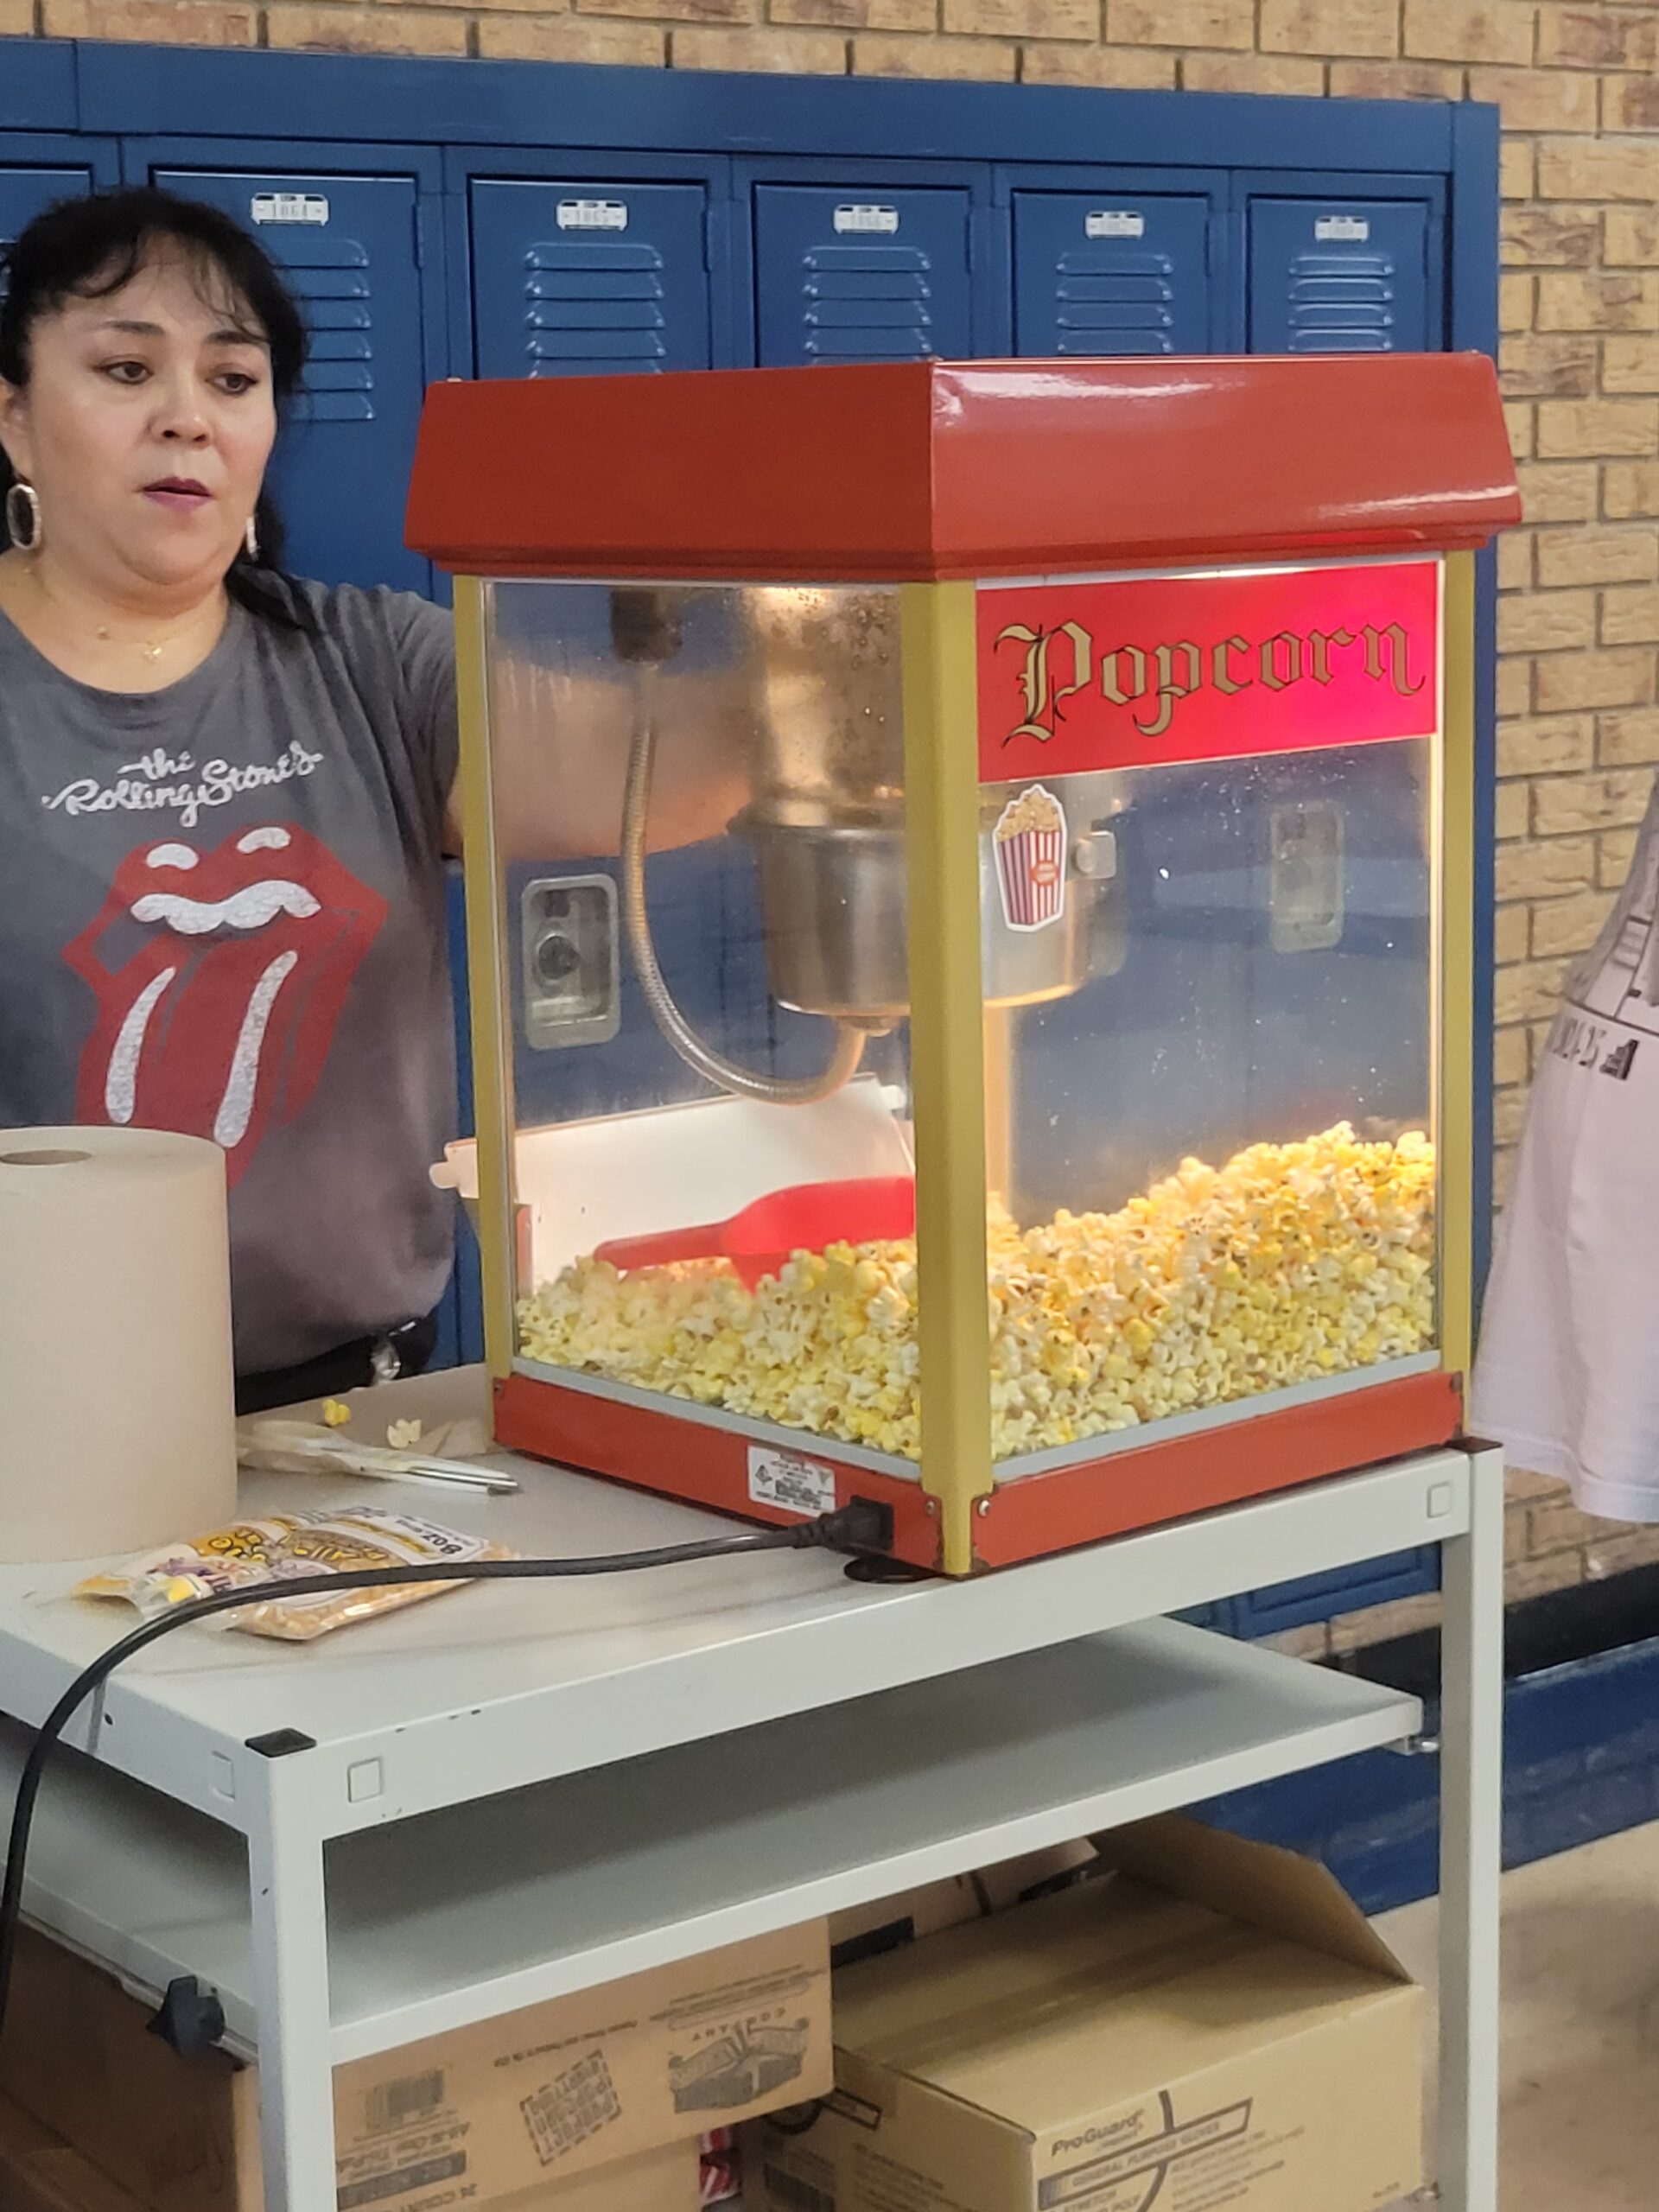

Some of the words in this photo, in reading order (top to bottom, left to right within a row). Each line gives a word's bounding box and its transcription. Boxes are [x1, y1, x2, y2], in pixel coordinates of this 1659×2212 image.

[994, 620, 1426, 748] Popcorn
[41, 777, 199, 827] Rolling
[197, 741, 325, 806] Stones
[118, 747, 196, 782] the
[1052, 2109, 1145, 2157] ProGuard
